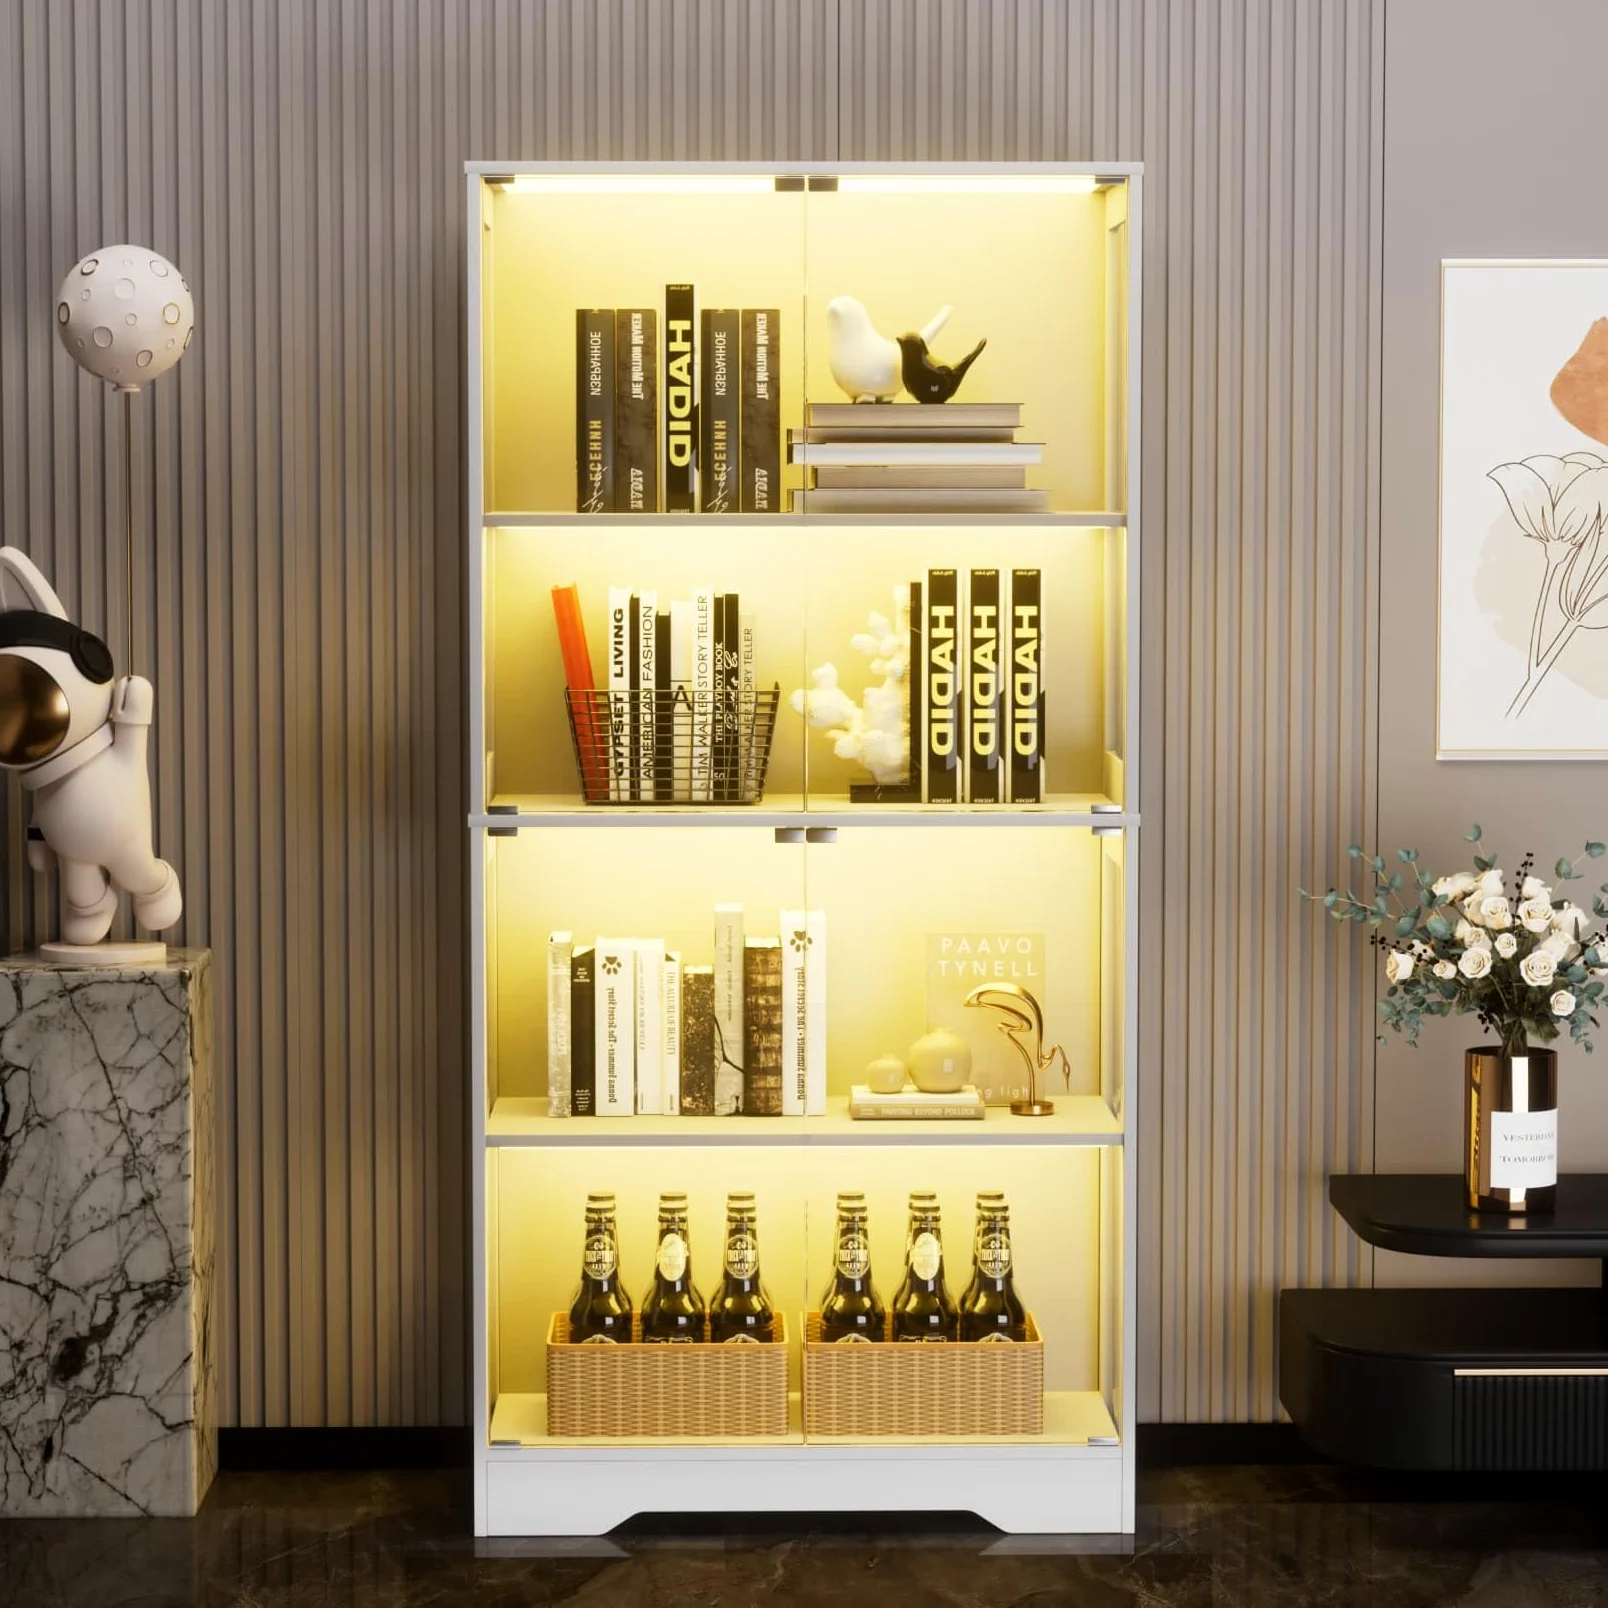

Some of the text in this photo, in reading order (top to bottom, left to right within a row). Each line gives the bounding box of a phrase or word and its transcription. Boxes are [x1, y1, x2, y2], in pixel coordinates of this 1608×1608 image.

[614, 608, 624, 777] GYPSET LIVING
[642, 606, 652, 780] AMERICAN FASHION
[698, 596, 708, 775] TIM WALKER STORY TELLER
[715, 642, 723, 742] THE PLAYBOY BOOK
[744, 628, 752, 665] TELLER
[938, 960, 1038, 977] TYNELL
[940, 938, 1032, 954] PAAVO
